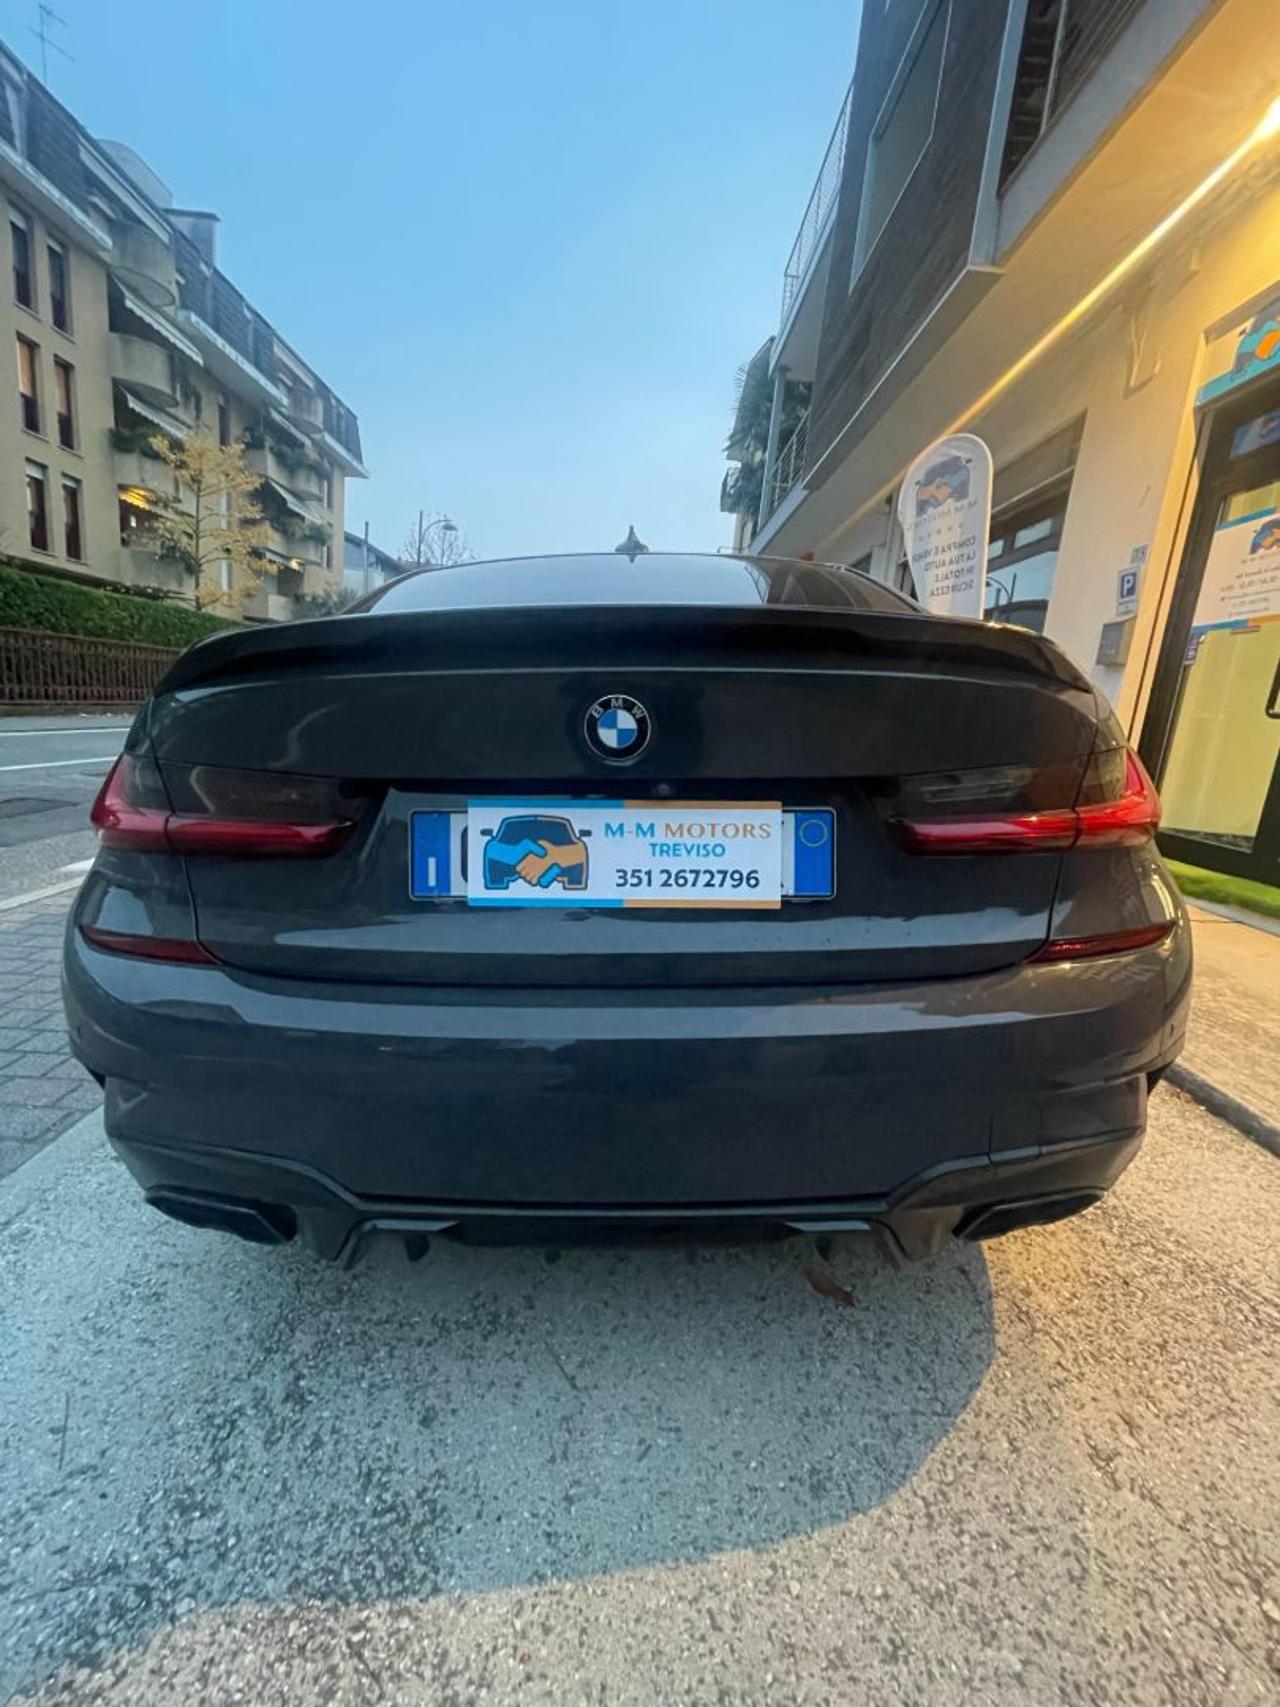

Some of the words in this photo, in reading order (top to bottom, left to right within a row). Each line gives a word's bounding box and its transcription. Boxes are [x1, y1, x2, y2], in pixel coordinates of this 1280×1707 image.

[1123, 575, 1134, 596] P
[605, 822, 654, 838] M-M
[664, 823, 771, 839] MOTORS
[649, 843, 726, 858] TREVISO
[615, 869, 652, 888] 351
[660, 869, 760, 888] 2672796
